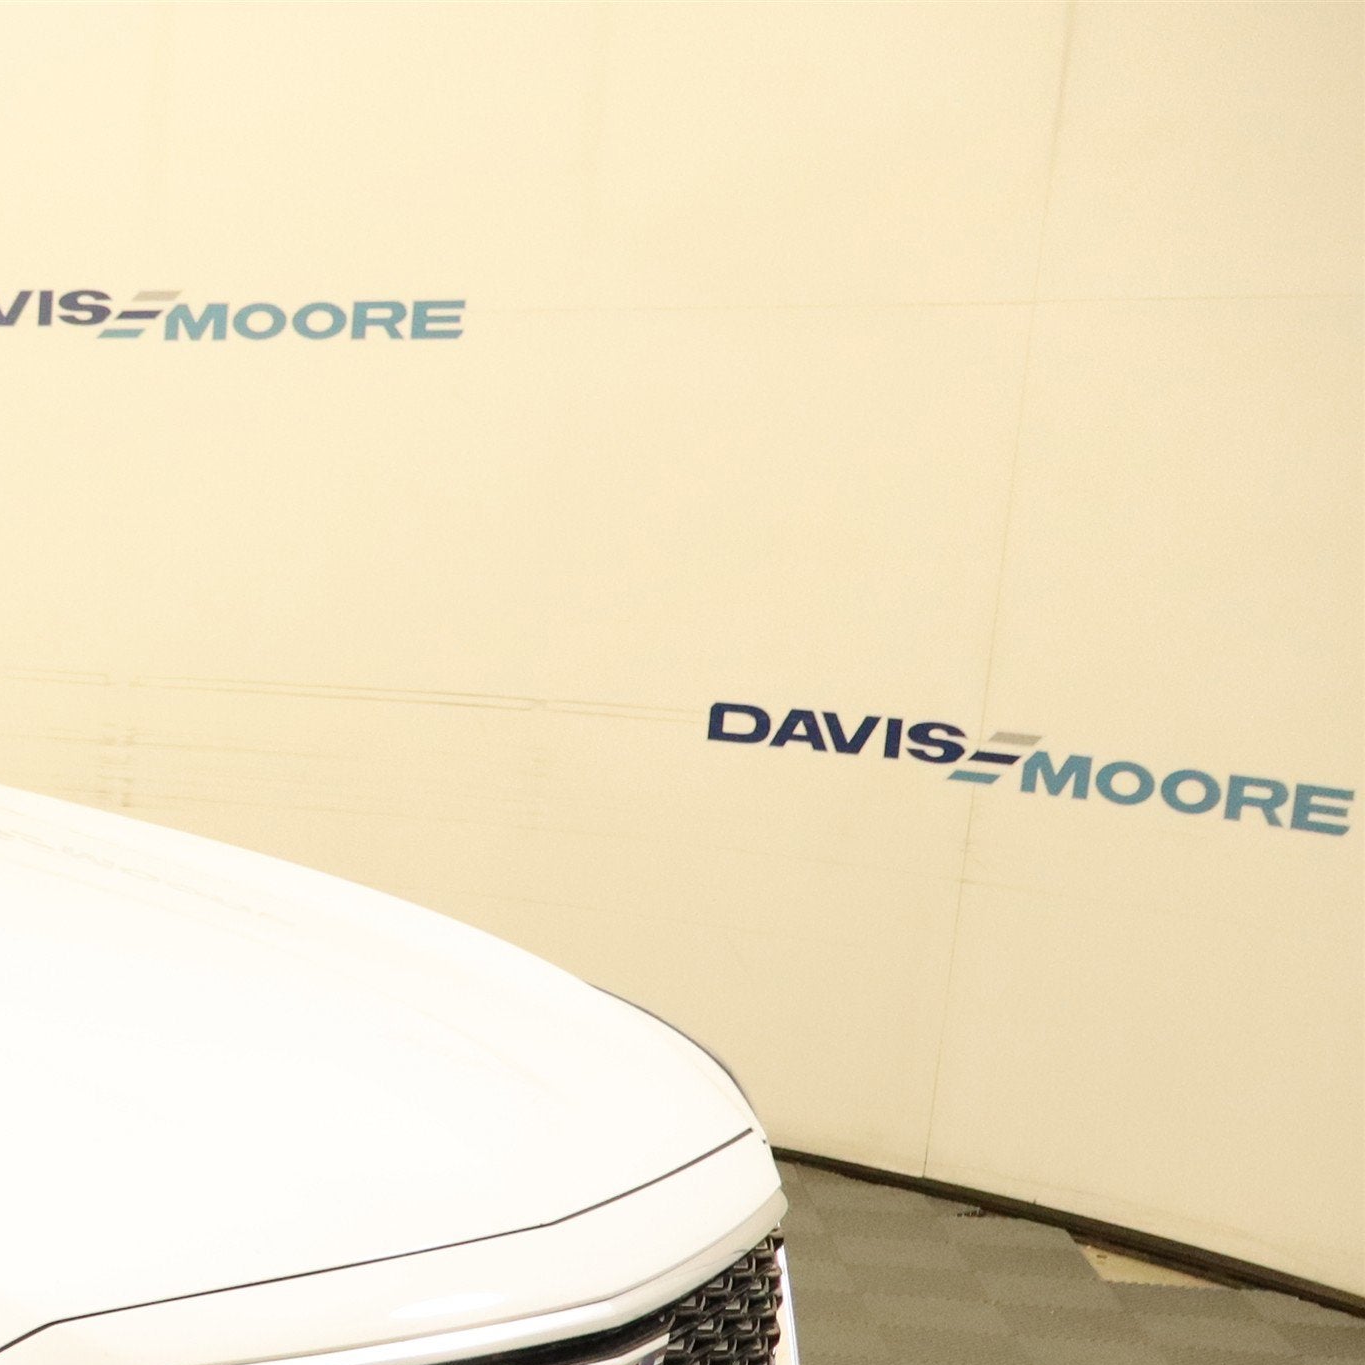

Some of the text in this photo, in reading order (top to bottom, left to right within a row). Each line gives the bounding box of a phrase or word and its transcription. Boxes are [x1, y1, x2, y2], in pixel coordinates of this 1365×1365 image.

[163, 299, 466, 341] MOORE
[707, 701, 1355, 837] DAVIS MOORE
